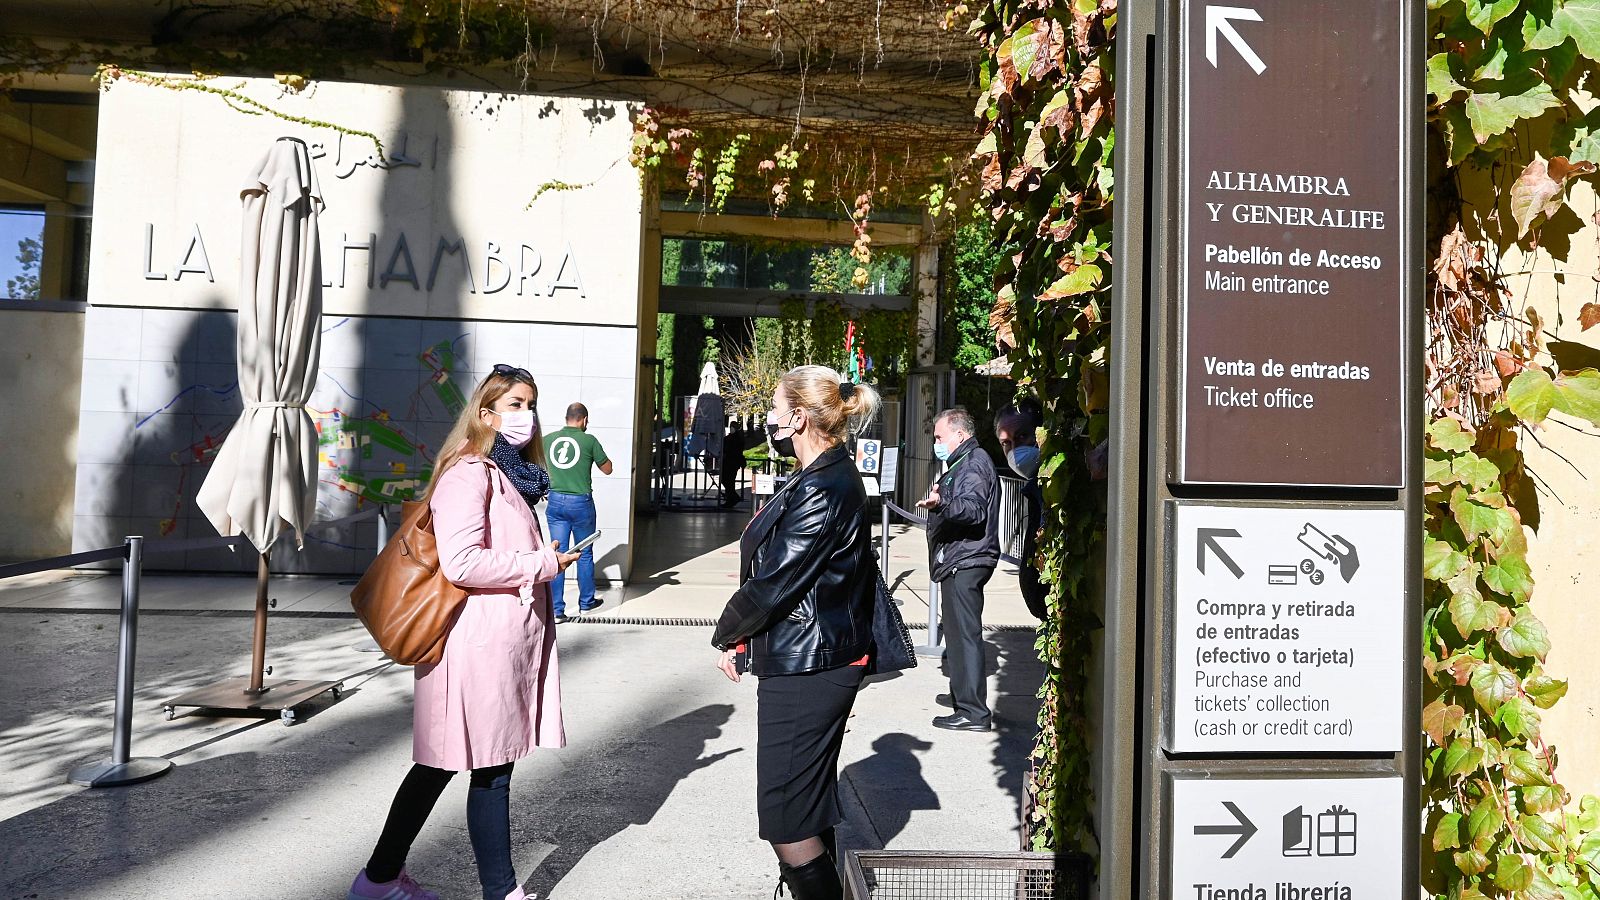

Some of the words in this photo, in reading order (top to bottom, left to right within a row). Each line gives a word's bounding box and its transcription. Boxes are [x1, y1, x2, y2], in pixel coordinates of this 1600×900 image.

[1205, 171, 1351, 197] ALHAMBRA
[1206, 202, 1225, 222] Y
[1231, 204, 1385, 230] GENERALIFE
[143, 222, 215, 283] LA
[320, 231, 587, 299] HAMBRA
[1205, 244, 1283, 266] Pabellón
[1288, 248, 1312, 267] de
[1316, 250, 1382, 270] Acceso
[1205, 271, 1246, 292] Main
[1252, 275, 1330, 296] entrance
[1204, 357, 1256, 377] Venta
[1261, 359, 1285, 378] de
[1290, 361, 1370, 381] entradas
[1204, 386, 1259, 408] Ticket
[1263, 388, 1314, 409] office
[1196, 599, 1266, 620] Compra
[1271, 604, 1282, 620] y
[1287, 601, 1355, 617] retirada
[1196, 623, 1218, 640] de
[1223, 624, 1300, 640] entradas
[1196, 647, 1271, 666] (efectivo
[1276, 652, 1287, 664] o
[1292, 648, 1354, 668] tarjeta)
[1195, 671, 1268, 688] Purchase
[1273, 672, 1301, 688] and
[1256, 695, 1329, 712] collection
[1194, 719, 1236, 737] (cash
[1242, 723, 1259, 736] or
[1264, 719, 1309, 736] credit
[1313, 719, 1353, 737] card)
[1193, 883, 1267, 900] Tienda
[1275, 882, 1352, 900] librería
